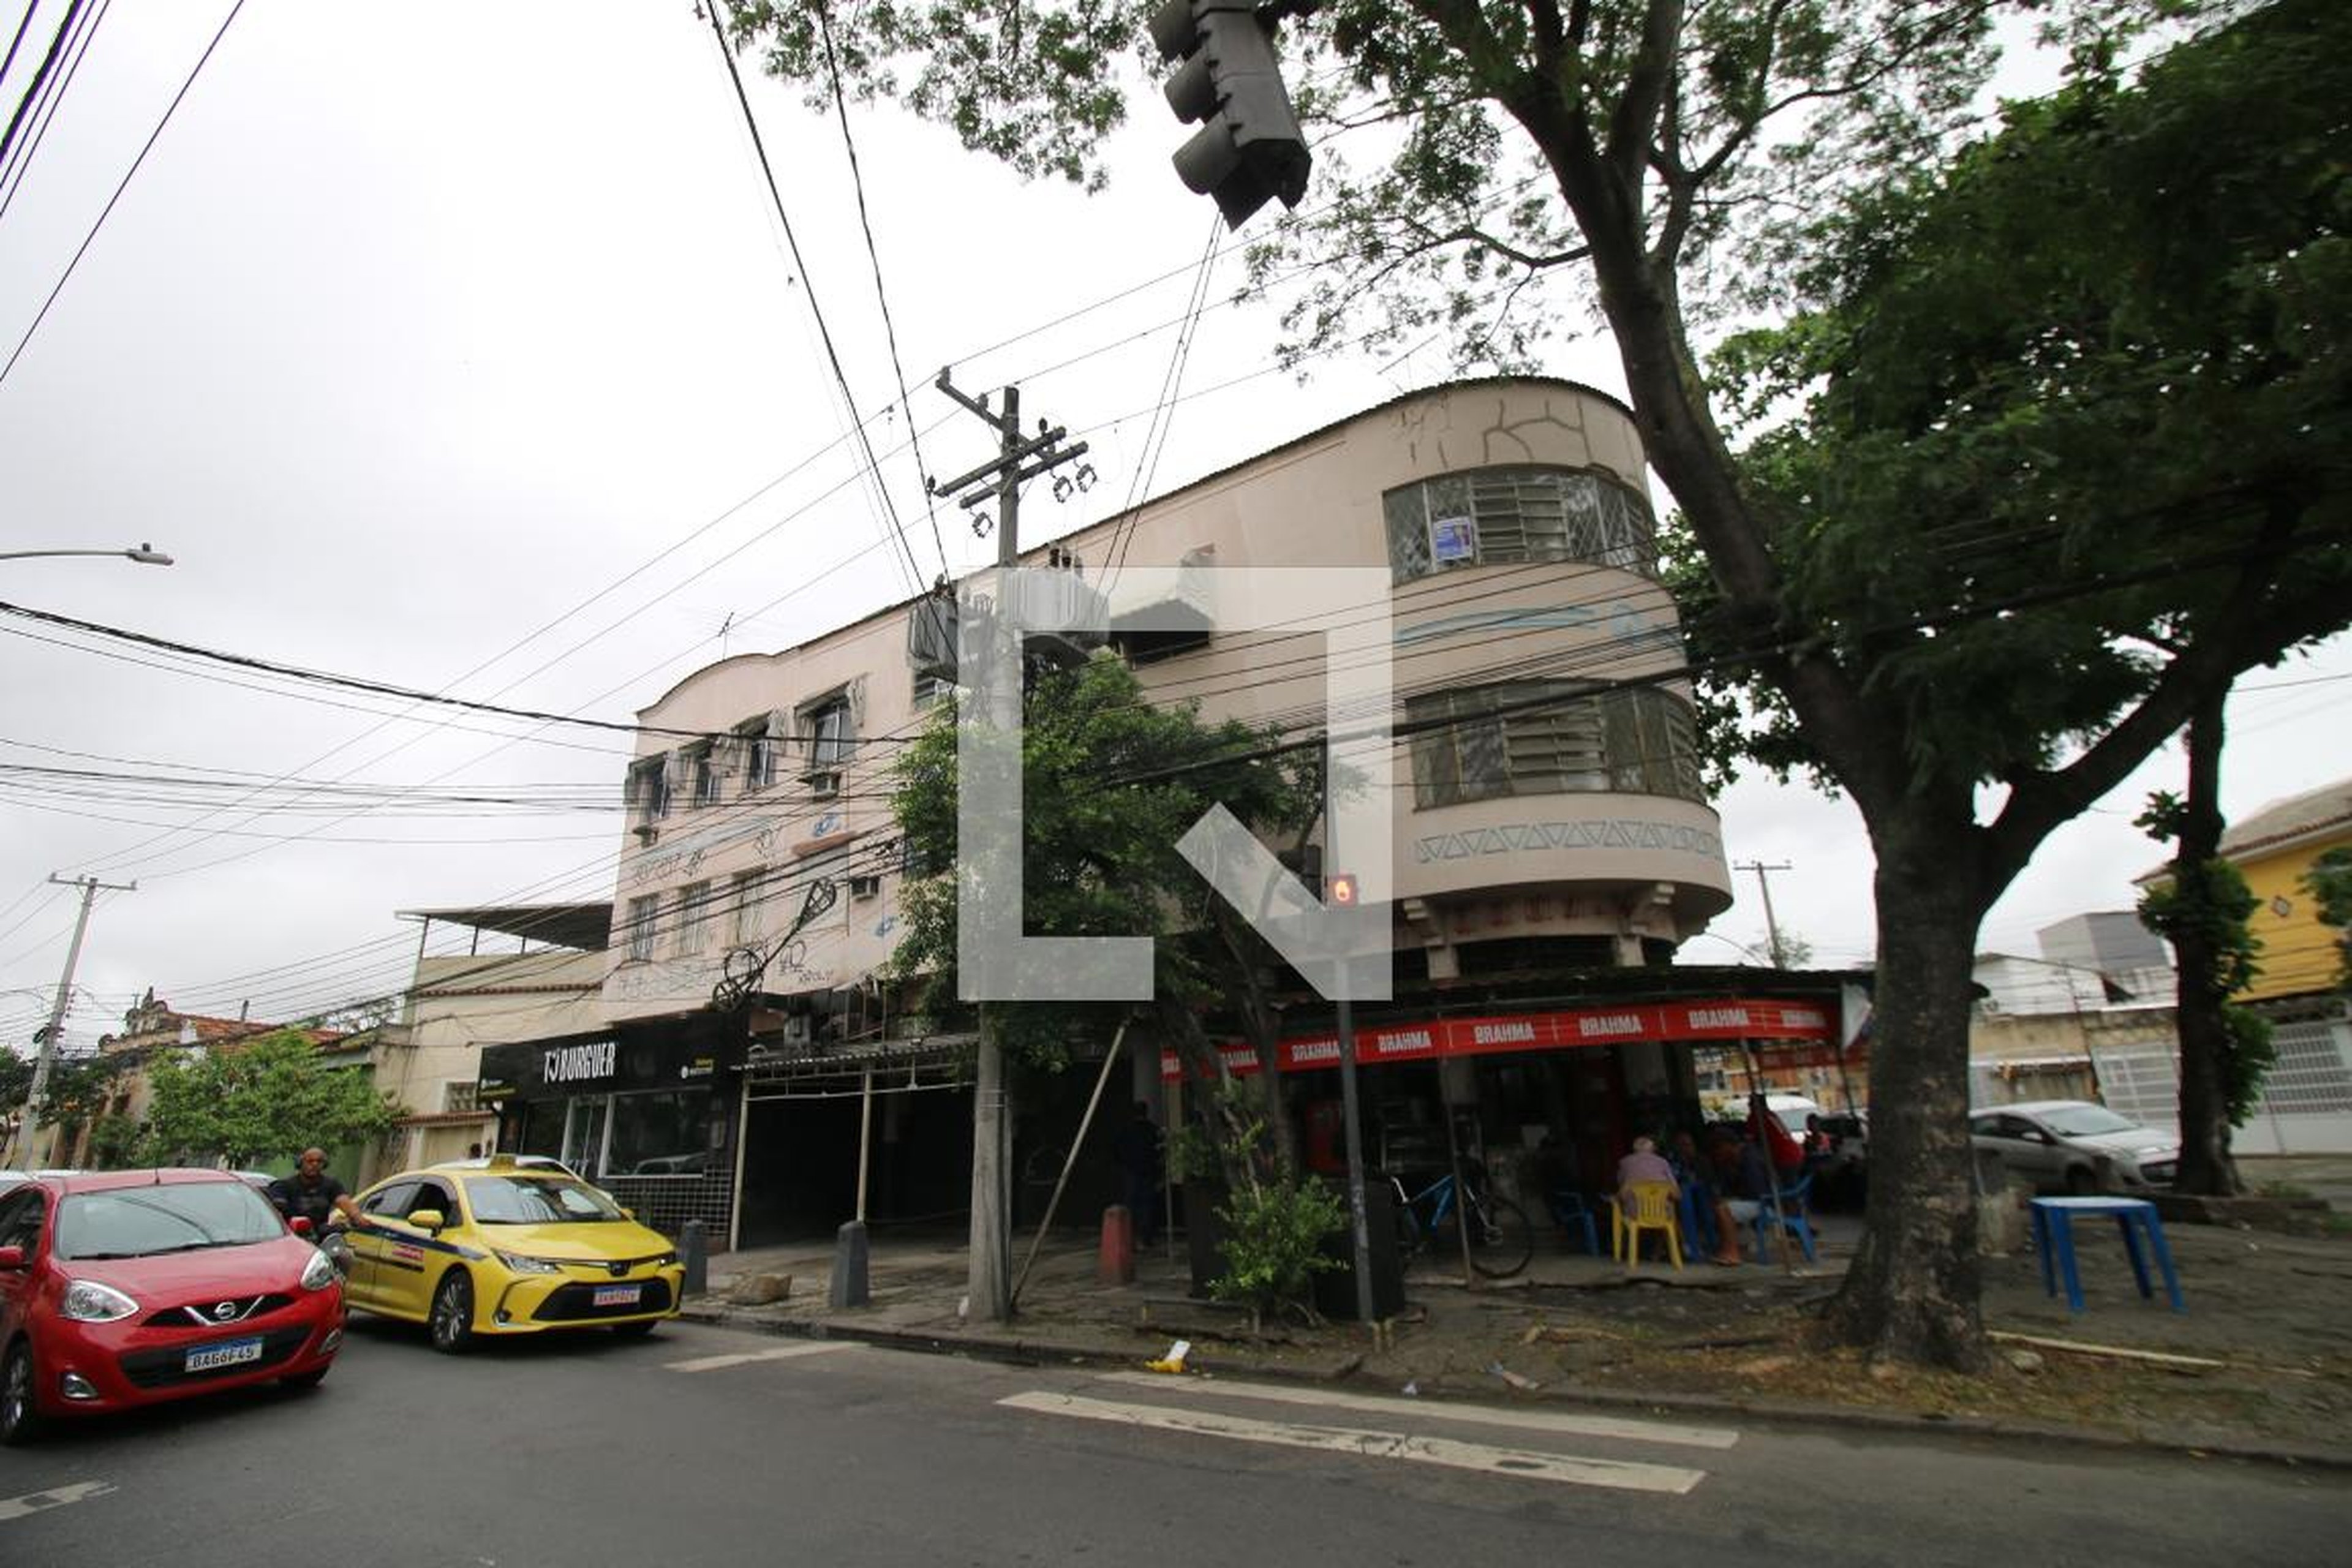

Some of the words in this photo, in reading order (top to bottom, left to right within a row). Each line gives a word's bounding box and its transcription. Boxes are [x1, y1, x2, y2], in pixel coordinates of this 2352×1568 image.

[1291, 1040, 1341, 1063] BRAHMA
[1378, 1030, 1432, 1053] BRAHMA
[1474, 1023, 1536, 1044] BRAHMA
[1579, 1014, 1643, 1036] BRAHMA
[1689, 1008, 1750, 1029] BRAHMA
